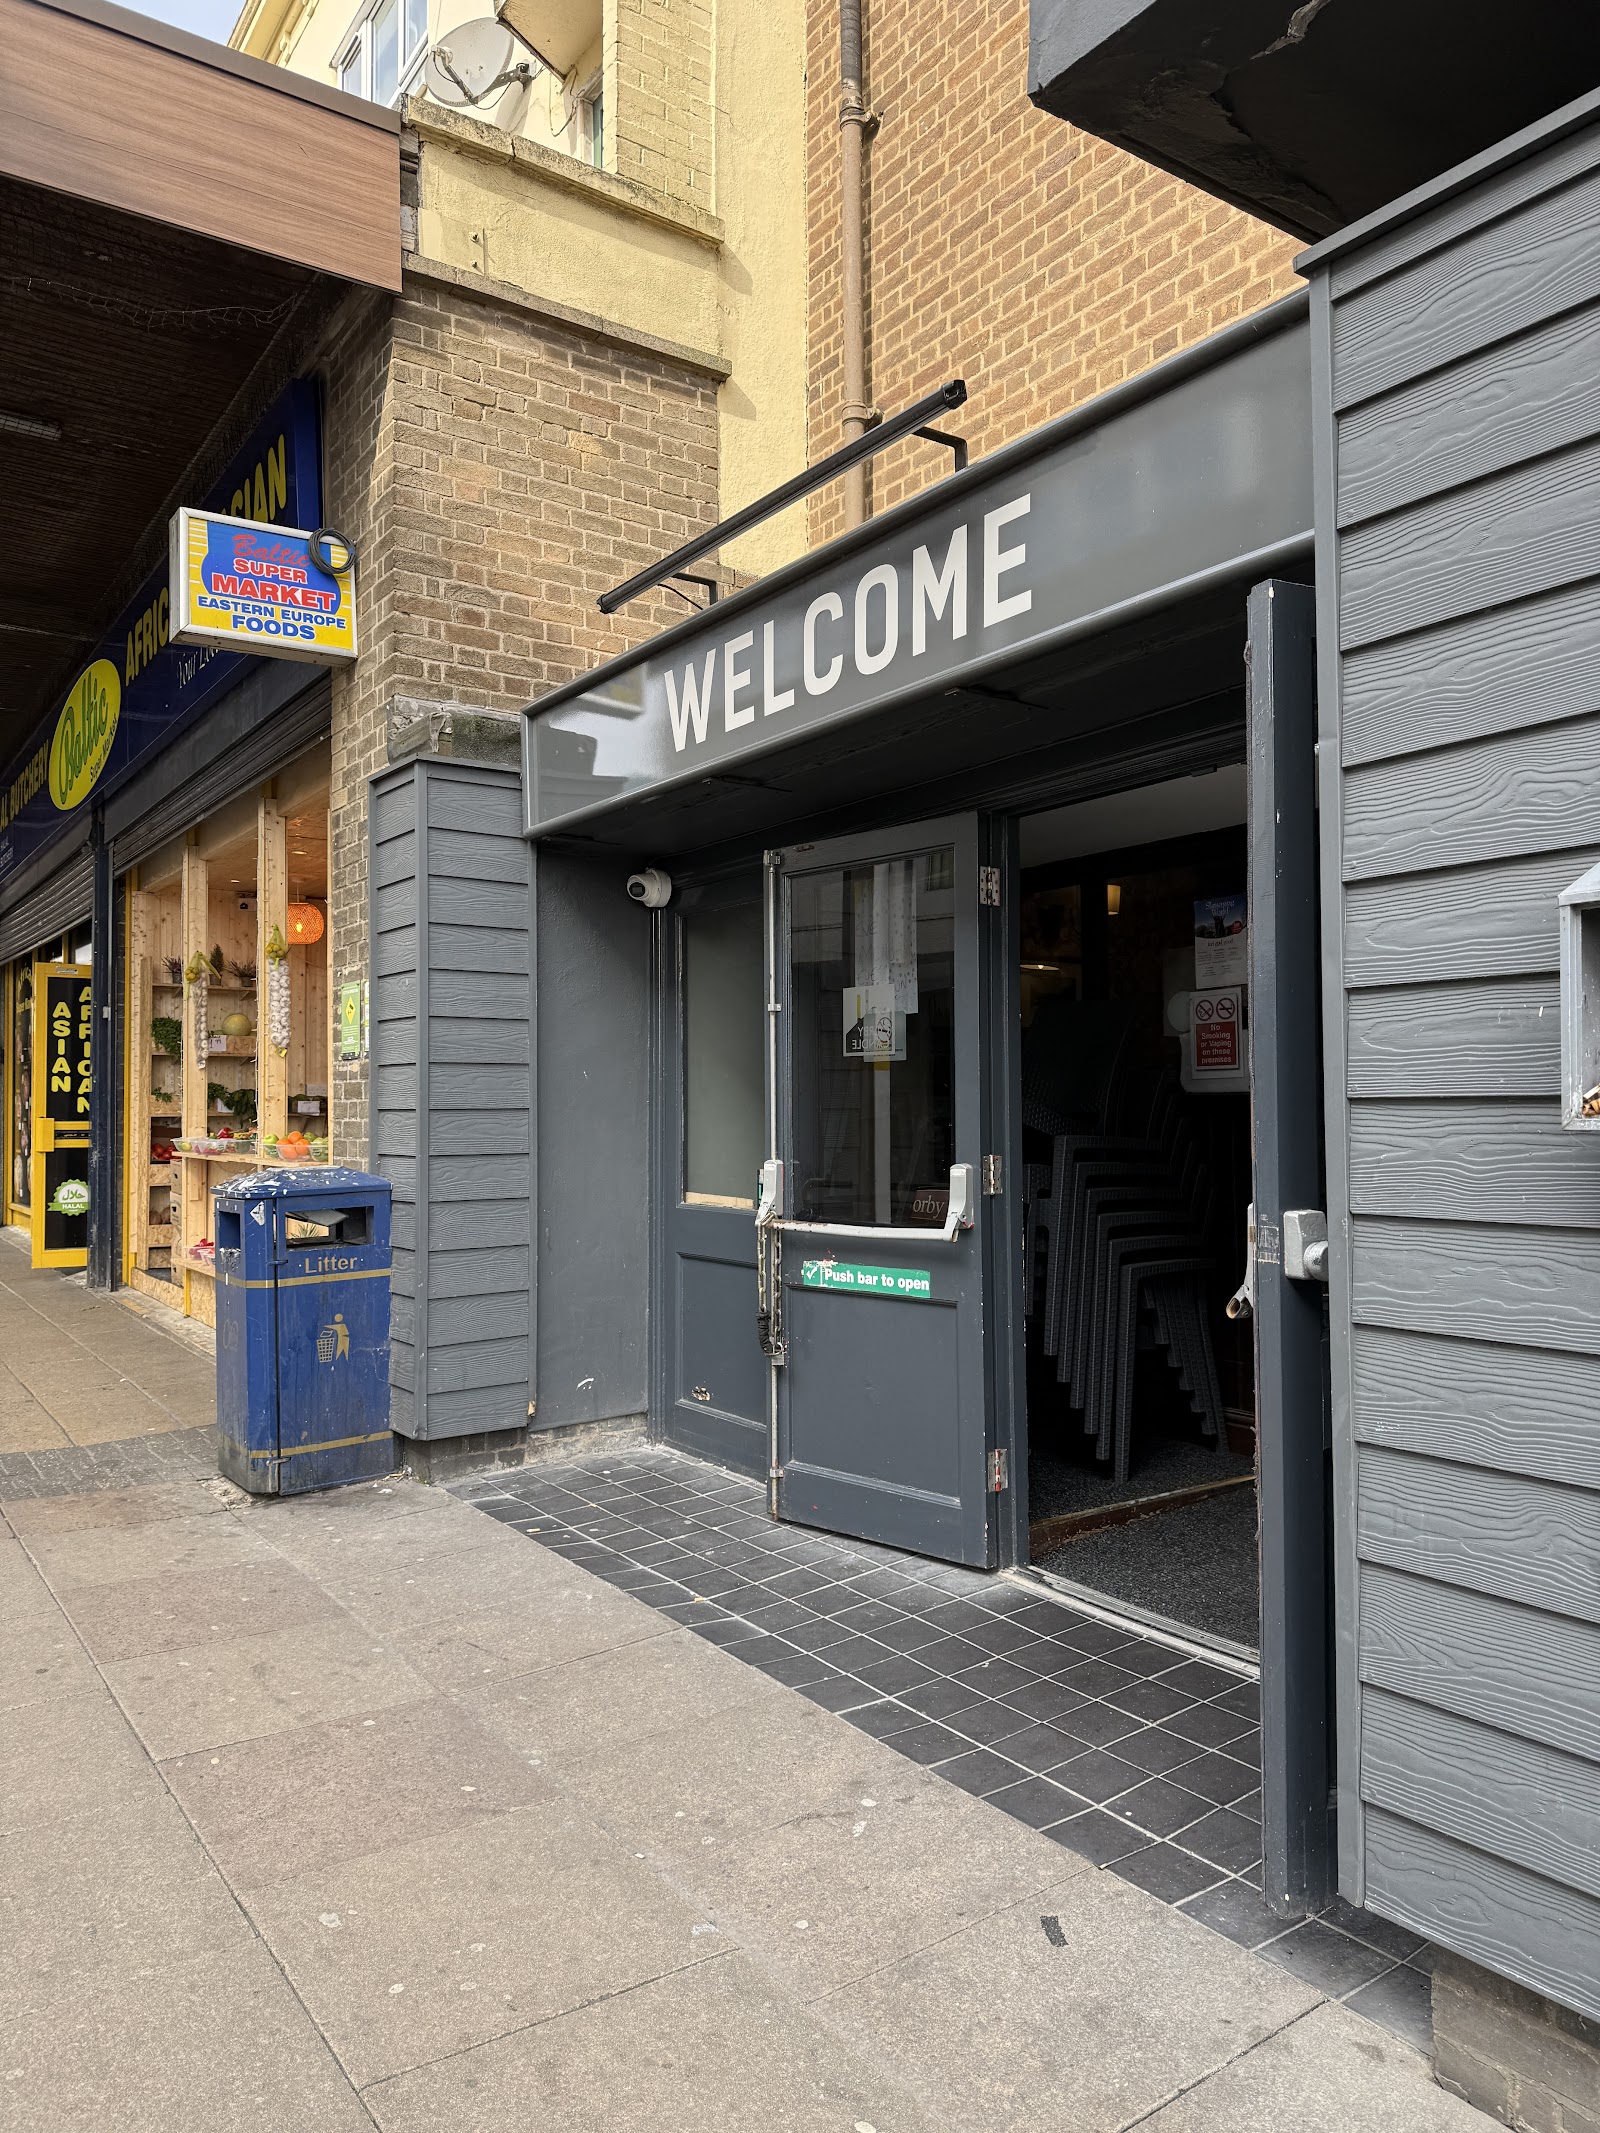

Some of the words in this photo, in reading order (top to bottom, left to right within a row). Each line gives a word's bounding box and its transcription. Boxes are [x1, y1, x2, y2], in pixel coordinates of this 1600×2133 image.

[126, 587, 168, 687] AFRIC
[222, 433, 287, 523] SIAN
[232, 534, 310, 567] Baltic
[234, 559, 308, 584] SUPER
[212, 573, 335, 611] MARKET
[198, 596, 275, 618] EASTERN
[281, 609, 346, 629] EUROPE
[232, 615, 315, 640] FOODS
[665, 493, 1032, 752] WELCOME
[59, 671, 108, 804] Baltic
[10, 739, 49, 821] BUTCHERY
[51, 1001, 71, 1093] ASIAN
[1201, 1032, 1231, 1040] Smoking
[1209, 1040, 1232, 1048] Vaping
[62, 1189, 86, 1201] حلال
[305, 1256, 358, 1273] Litter
[825, 1267, 854, 1283] Push
[858, 1271, 879, 1286] bar
[882, 1274, 894, 1287] to
[898, 1278, 930, 1292] open
